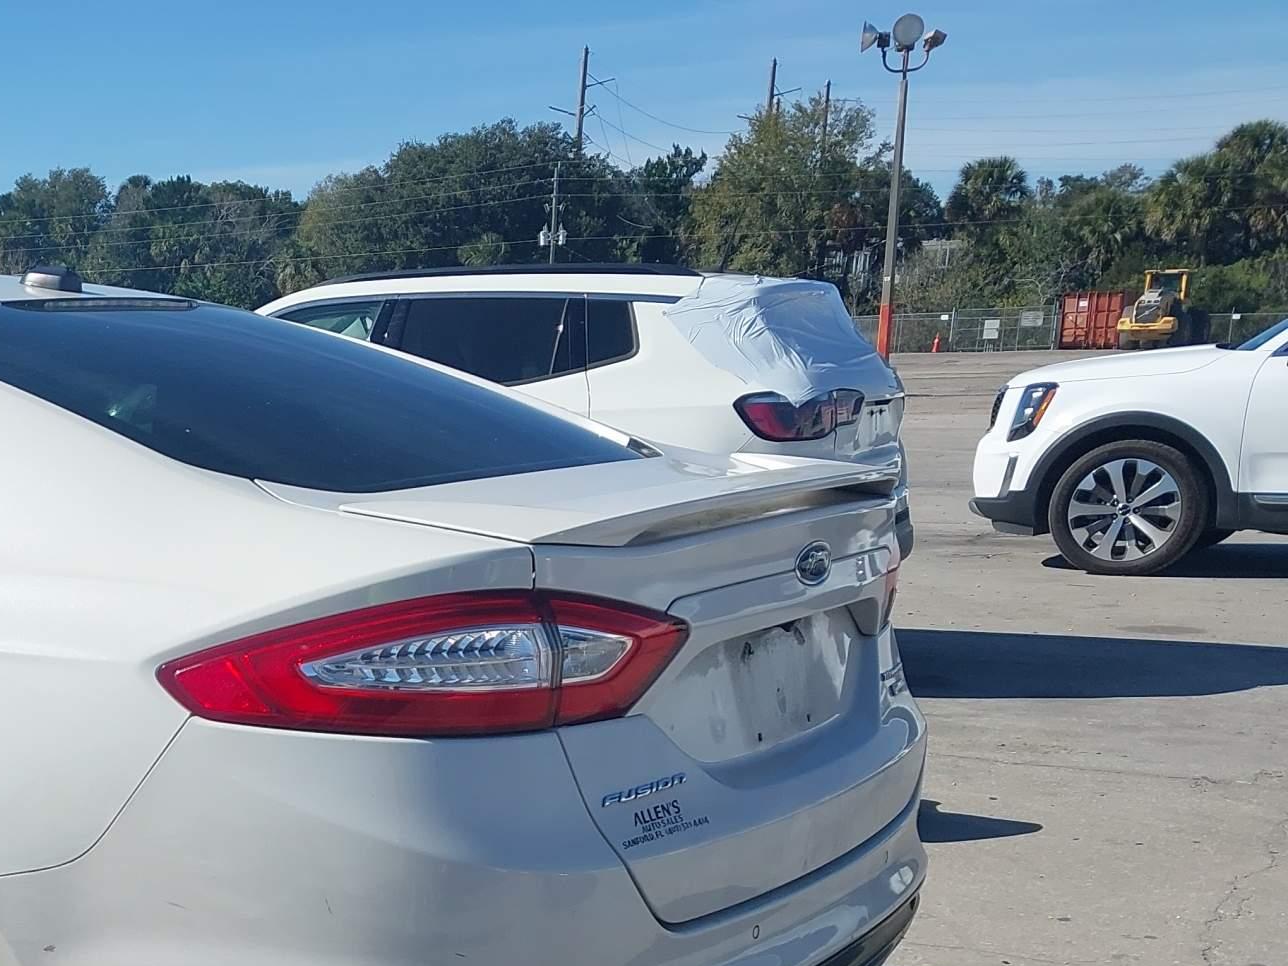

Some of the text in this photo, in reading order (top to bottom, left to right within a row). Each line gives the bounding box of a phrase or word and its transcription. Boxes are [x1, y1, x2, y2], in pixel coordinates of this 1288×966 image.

[601, 772, 688, 808] FUSION
[633, 799, 681, 827] ALLEN'S
[642, 814, 684, 834] AUTO SALES
